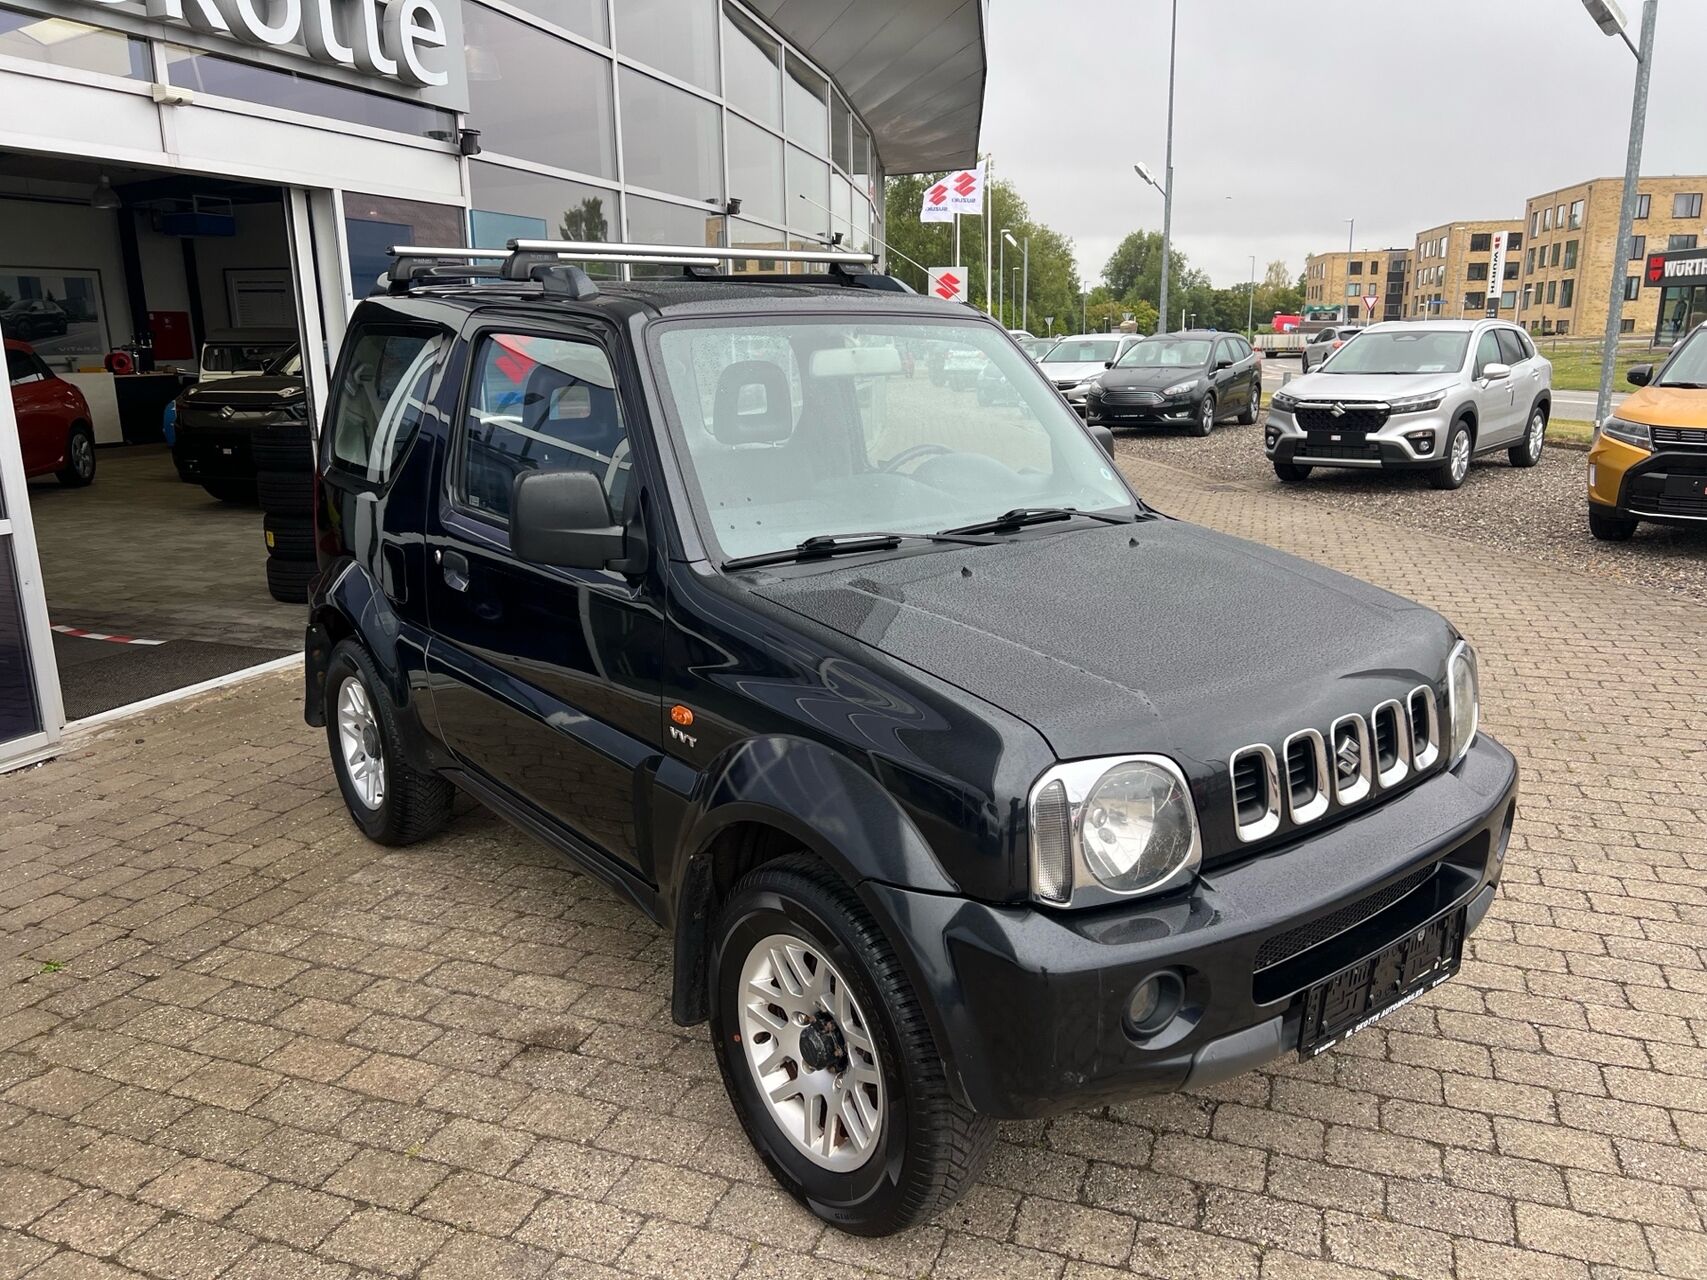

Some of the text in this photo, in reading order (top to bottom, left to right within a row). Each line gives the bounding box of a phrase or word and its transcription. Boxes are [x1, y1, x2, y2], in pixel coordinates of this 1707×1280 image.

[1664, 257, 1707, 278] WÜRTH
[669, 725, 698, 748] VVT
[1355, 1012, 1380, 1033] SKOTTE
